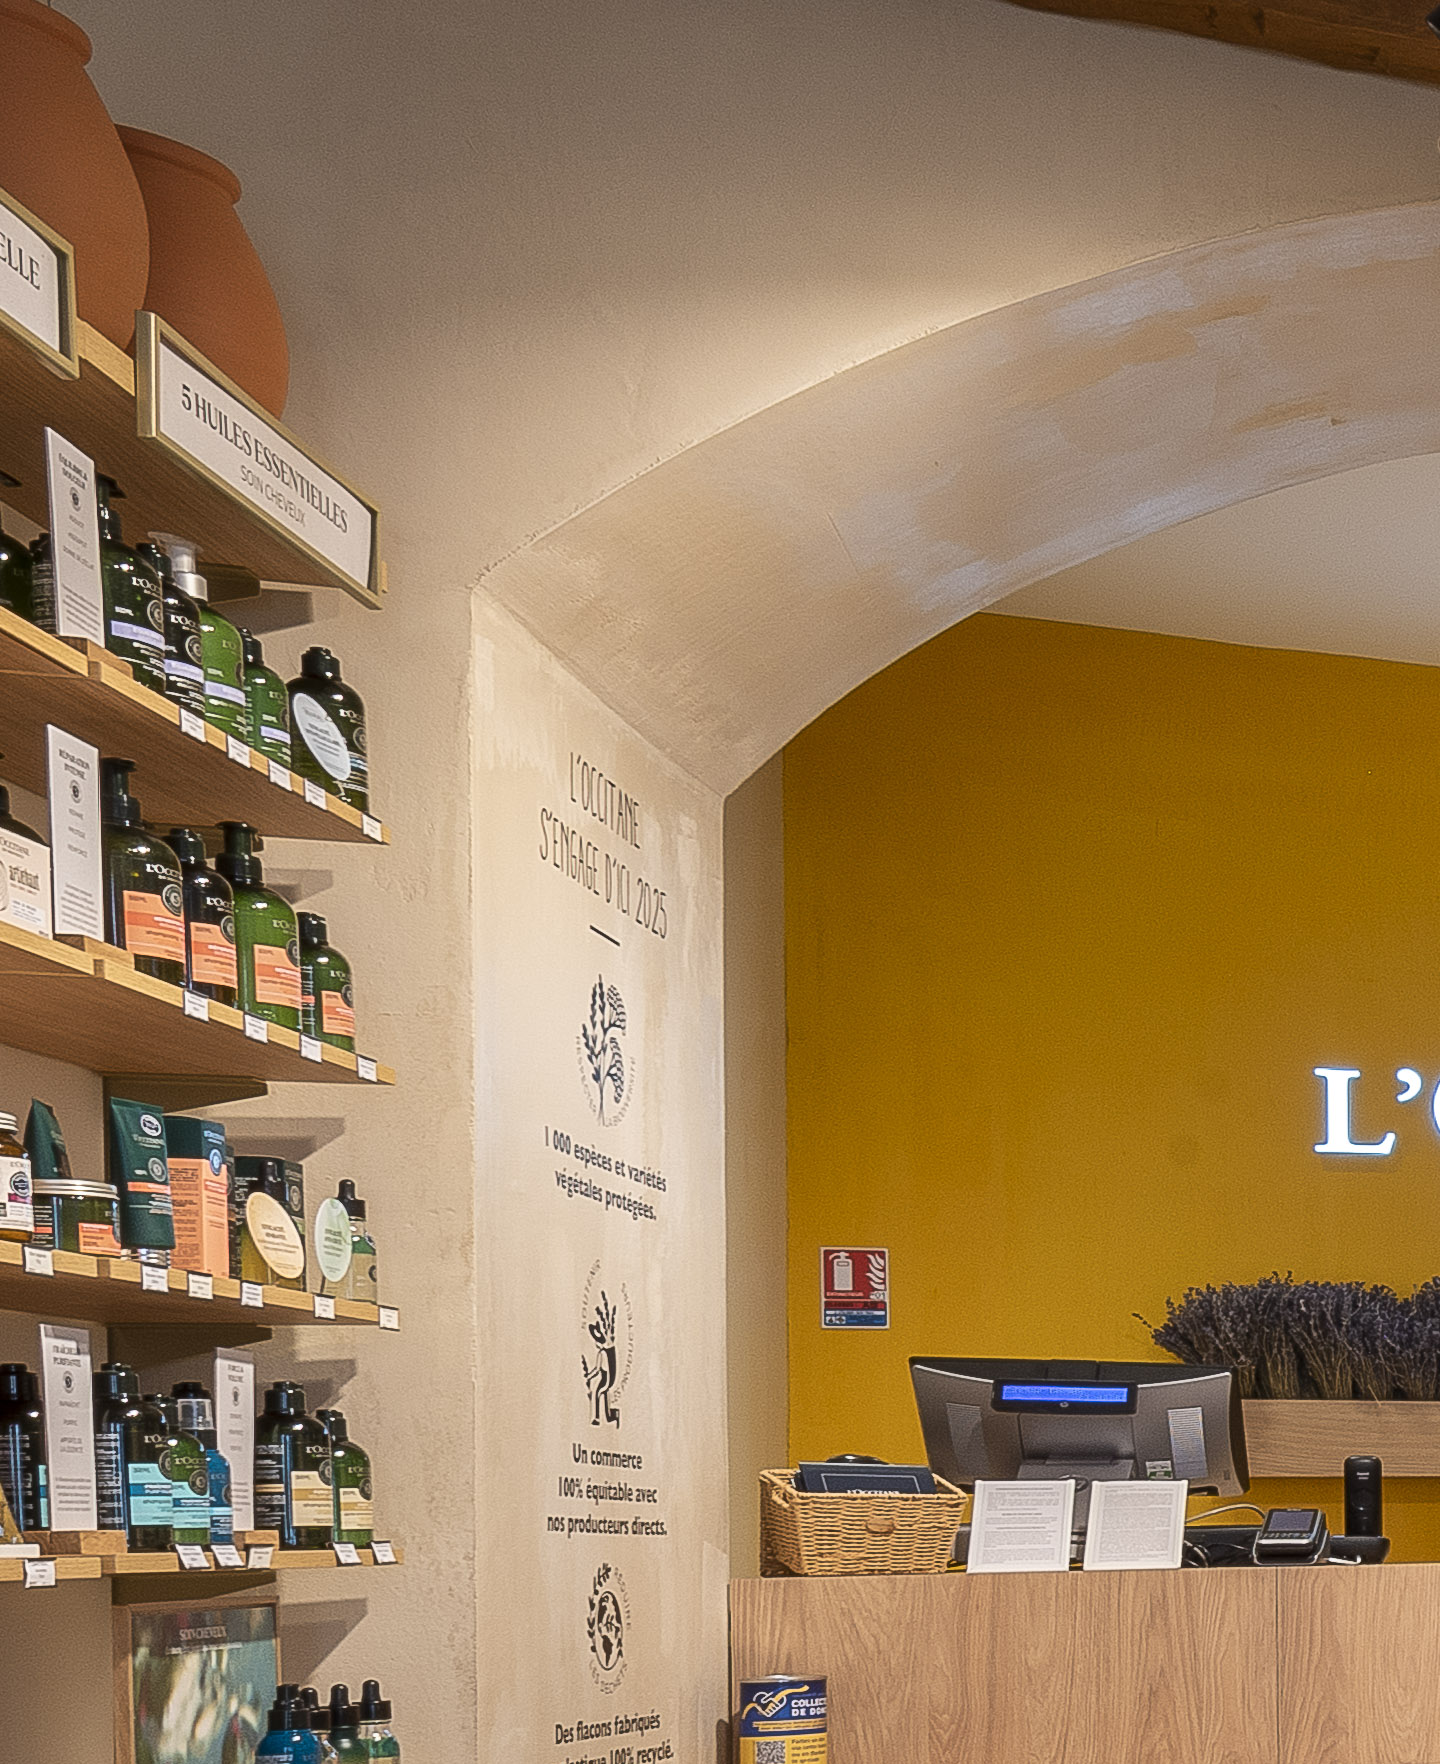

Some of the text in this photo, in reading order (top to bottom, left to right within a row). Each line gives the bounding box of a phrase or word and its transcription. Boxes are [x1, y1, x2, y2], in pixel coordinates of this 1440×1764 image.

[181, 383, 348, 533] 5 HUILES ESSENTIELLES
[239, 465, 307, 526] SOIN CHEVEUX
[570, 751, 641, 849] L'OCCITANE
[539, 807, 668, 940] S'ENGAGE D'ICI 2025
[555, 1167, 657, 1221] végétales protégées.
[574, 1143, 612, 1172] espèces
[614, 1159, 626, 1178] et
[627, 1164, 667, 1193] variétés
[572, 1442, 643, 1470] Un commerce
[558, 1475, 658, 1506] 100% équitable avec
[547, 1513, 668, 1539] nos producteurs directs.
[555, 1708, 661, 1745] Des flacons fabriqués
